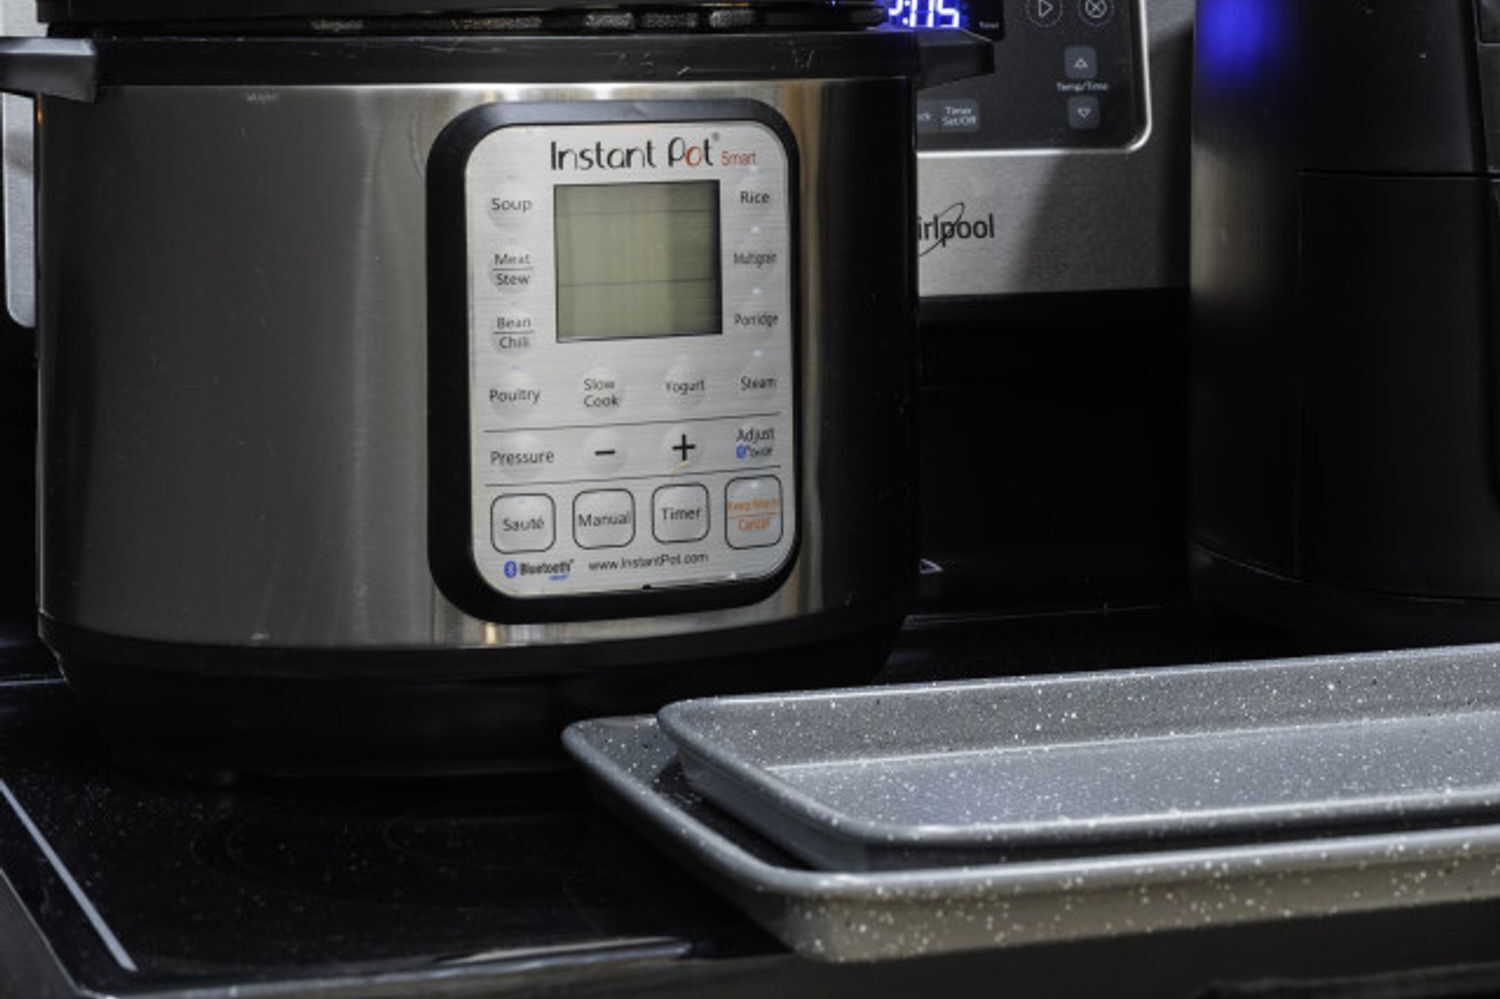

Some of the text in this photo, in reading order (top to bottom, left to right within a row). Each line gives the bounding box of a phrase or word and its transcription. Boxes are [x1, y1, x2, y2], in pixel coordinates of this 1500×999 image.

[550, 140, 657, 171] Instant
[739, 190, 771, 204] Rice
[491, 197, 533, 214] Soup
[917, 212, 995, 247] irlpool
[494, 253, 532, 265] Meat
[495, 272, 531, 286] Stew
[496, 316, 532, 329] Bean
[498, 335, 531, 349] Chili
[583, 378, 616, 391] Slow
[665, 379, 706, 396] Yogurt
[740, 375, 777, 391] Steam
[488, 388, 541, 404] Poultry
[583, 394, 620, 408] Cook
[736, 426, 776, 444] Adjust
[490, 449, 555, 466] Pressure
[577, 511, 632, 529] Manual
[660, 506, 703, 522] Timer
[588, 551, 710, 572] www.InstantPot.com
